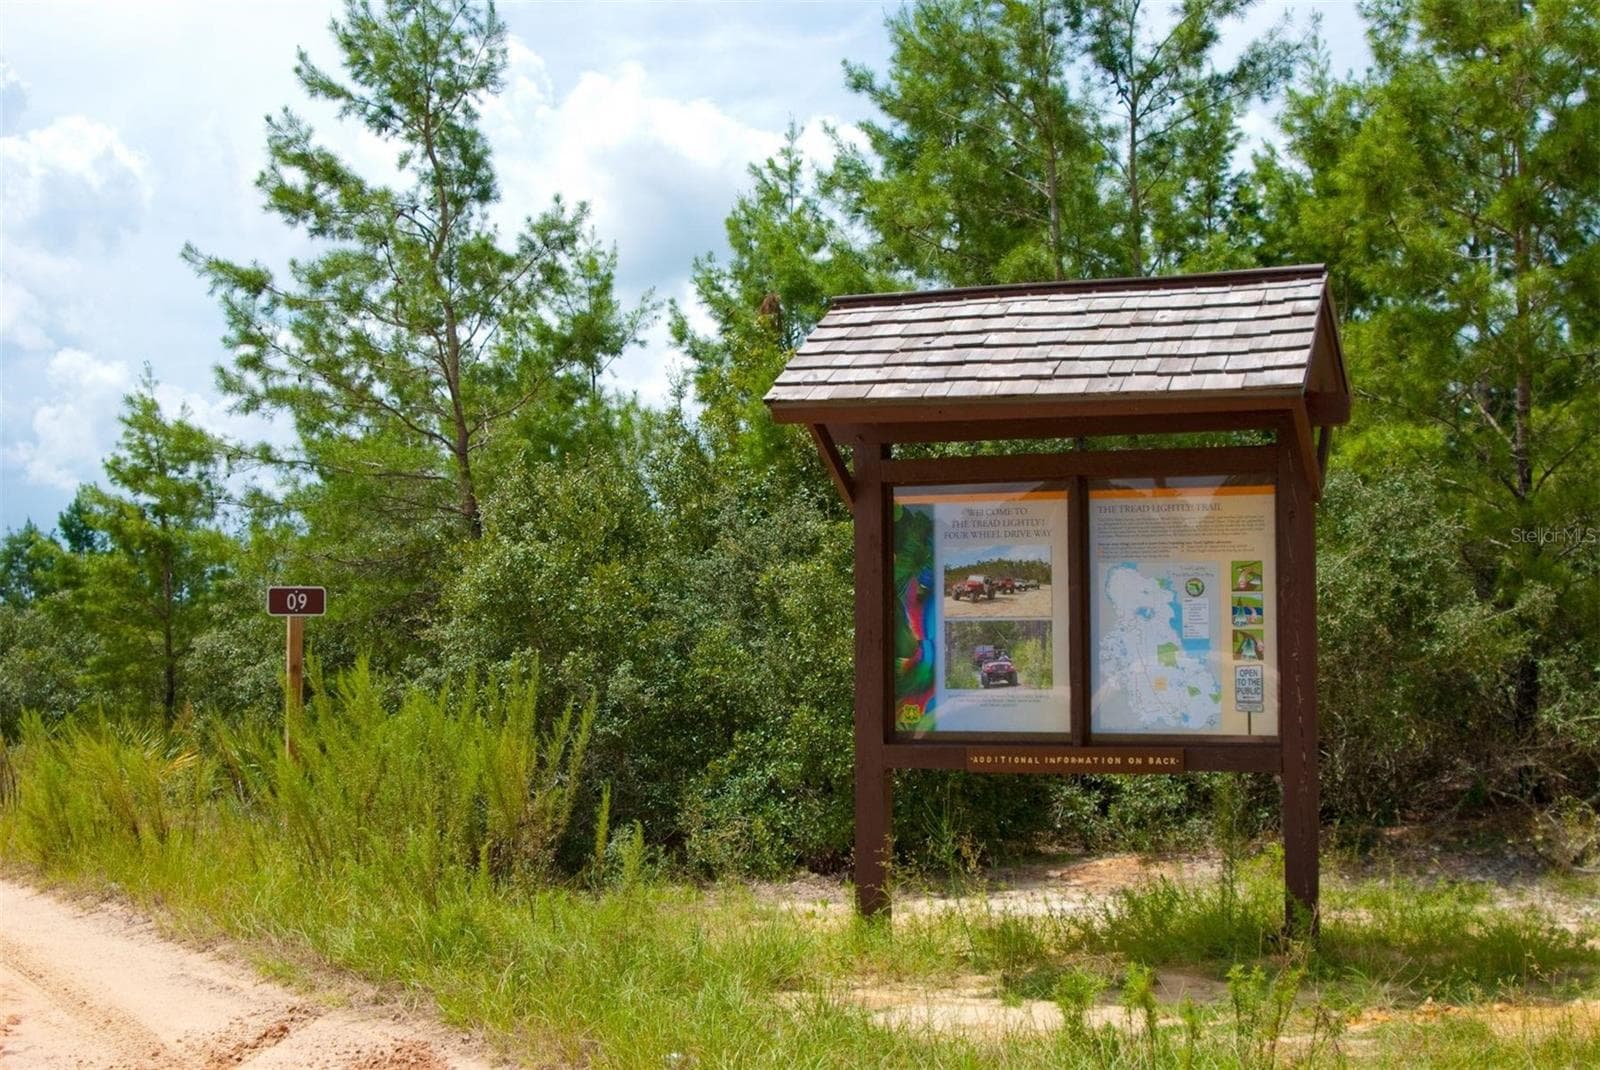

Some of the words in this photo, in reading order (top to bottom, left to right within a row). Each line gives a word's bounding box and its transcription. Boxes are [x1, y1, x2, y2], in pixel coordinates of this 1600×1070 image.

[967, 507, 1012, 517] WELCOME
[1015, 507, 1028, 516] TO
[1098, 505, 1115, 514] THE
[1119, 504, 1150, 513] TREAD
[1196, 502, 1223, 511] TRAIL
[952, 519, 968, 529] THE
[972, 519, 1001, 528] TREAD
[944, 531, 969, 540] FOUR
[970, 530, 1002, 540] WHEEL
[1004, 529, 1031, 539] DRIVE
[1032, 529, 1053, 538] WAY
[1239, 668, 1258, 678] OPEN
[1237, 678, 1246, 687] TO
[1248, 678, 1261, 687] THE
[1237, 687, 1261, 696] PUBLIC
[973, 756, 1040, 764] ADDITIONAL
[1044, 756, 1121, 765] INFORMATION
[1128, 757, 1142, 765] ON
[1148, 757, 1175, 765] BACK
